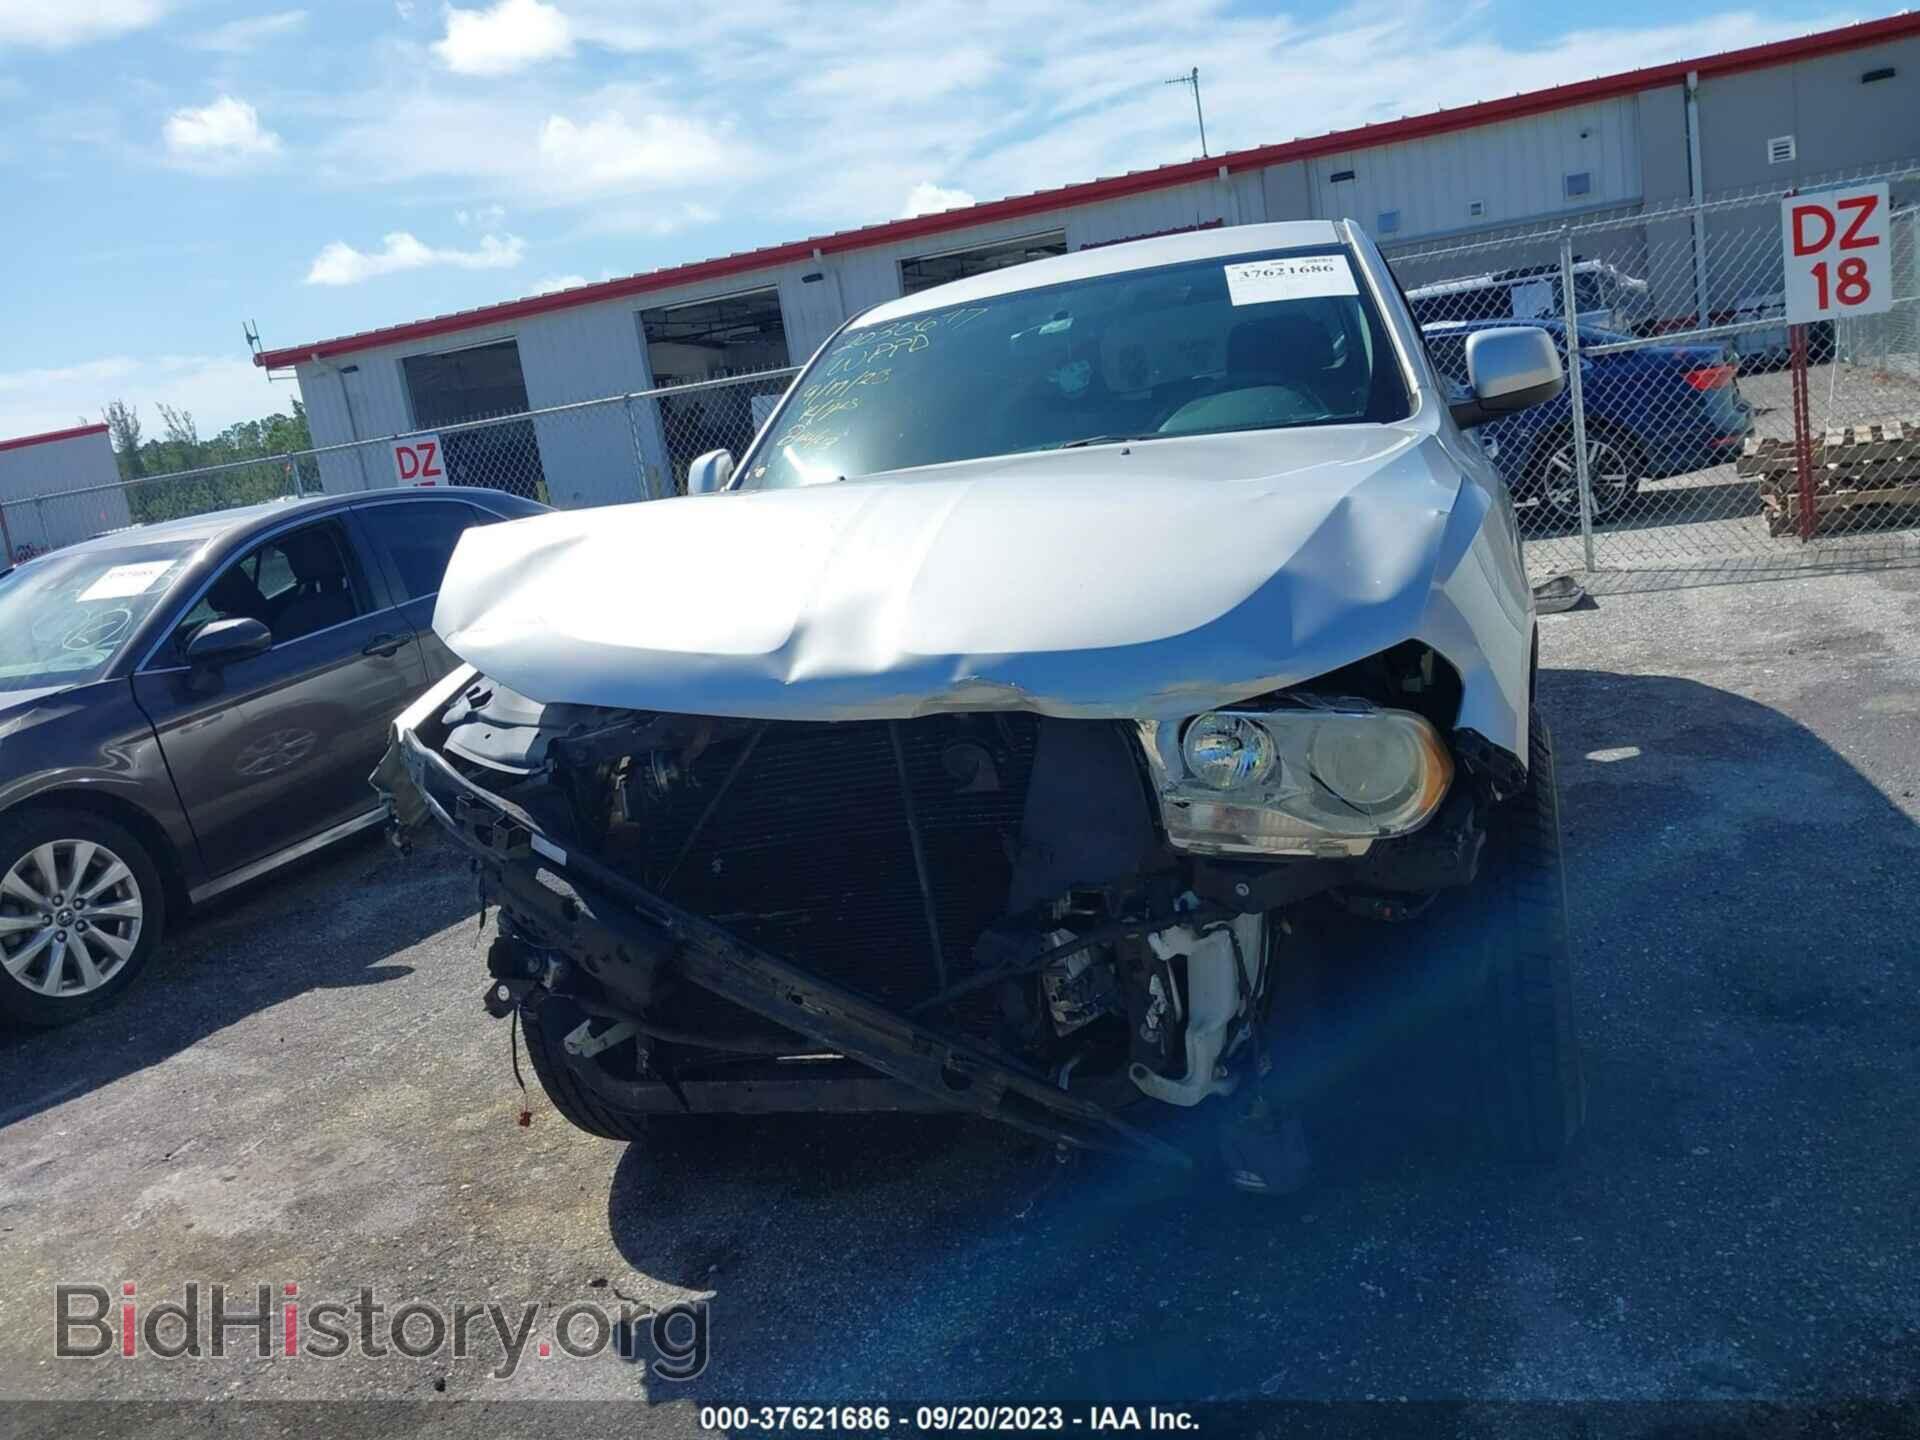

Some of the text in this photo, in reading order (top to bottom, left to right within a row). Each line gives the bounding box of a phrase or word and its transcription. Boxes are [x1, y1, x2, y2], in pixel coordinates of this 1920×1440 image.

[1792, 195, 1879, 256] DZ
[1242, 265, 1334, 278] 37621686
[1811, 257, 1871, 310] 18
[395, 442, 441, 479] DZ
